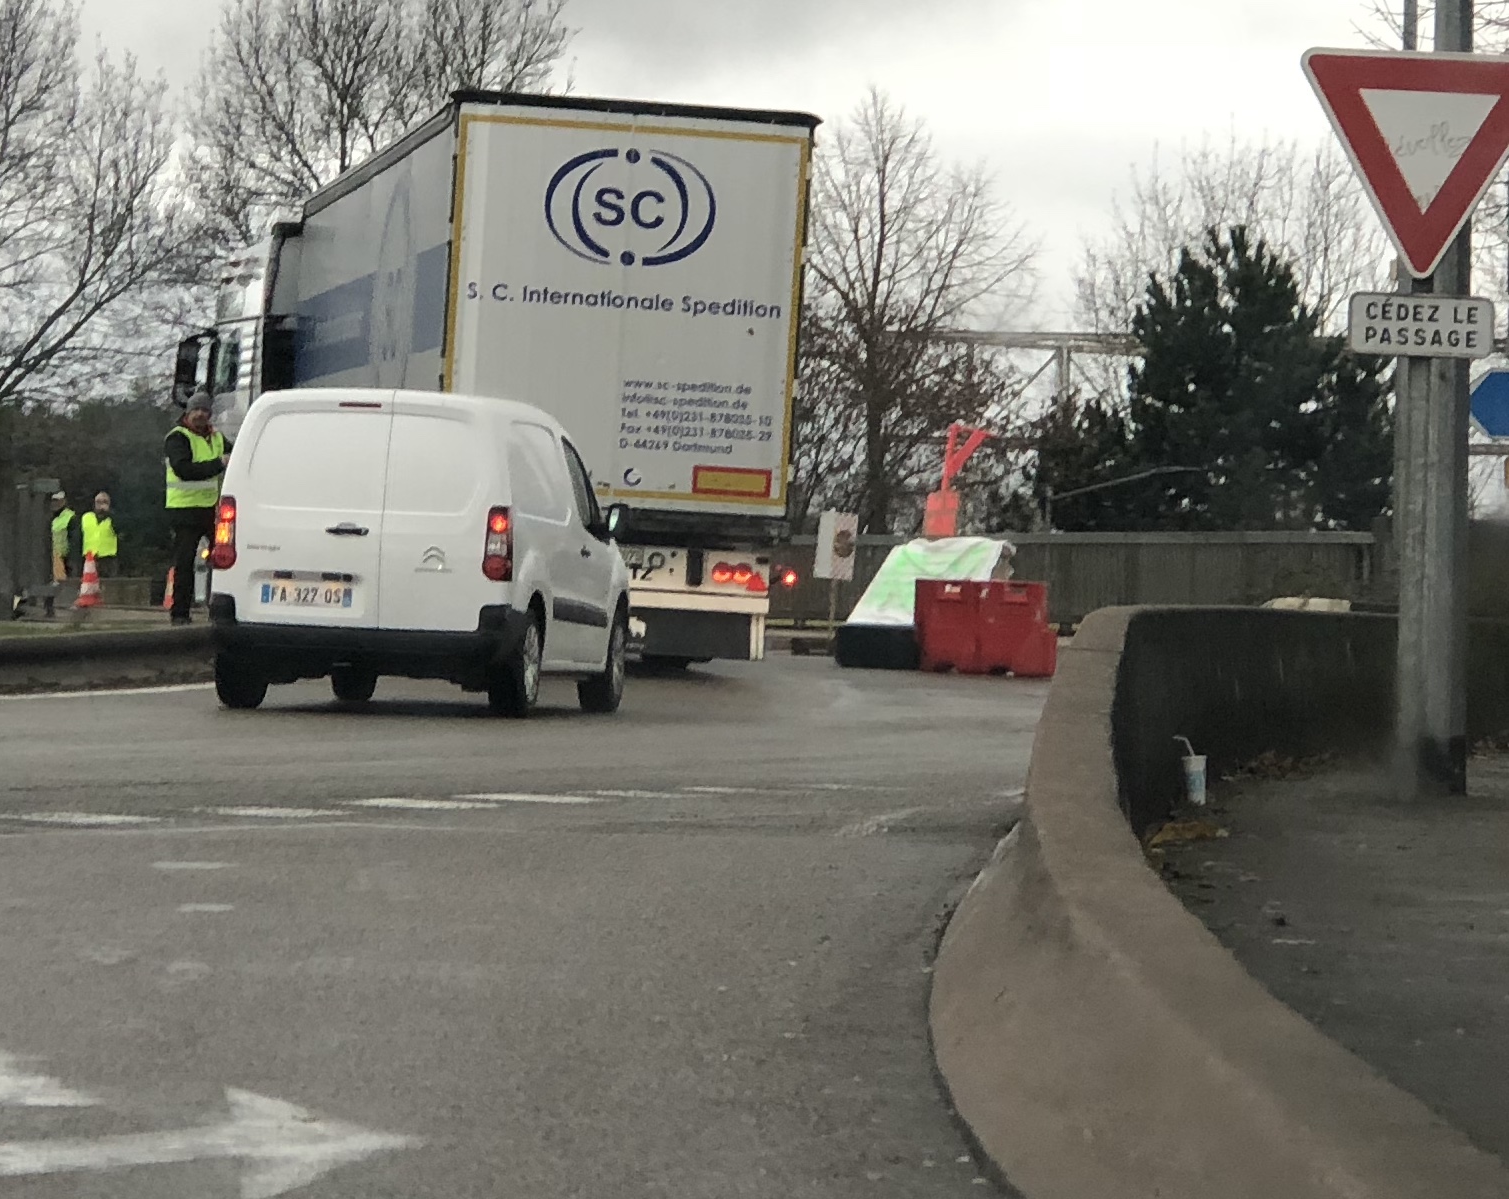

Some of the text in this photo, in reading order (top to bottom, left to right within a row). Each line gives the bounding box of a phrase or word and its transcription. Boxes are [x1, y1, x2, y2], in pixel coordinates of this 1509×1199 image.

[592, 187, 665, 229] SC
[491, 283, 514, 302] C.
[522, 285, 674, 312] Internationale
[681, 295, 781, 319] Spedition
[1365, 297, 1479, 325] CÉDEZ LE
[1365, 326, 1479, 349] PASSAGE
[672, 440, 733, 455] Dortmund
